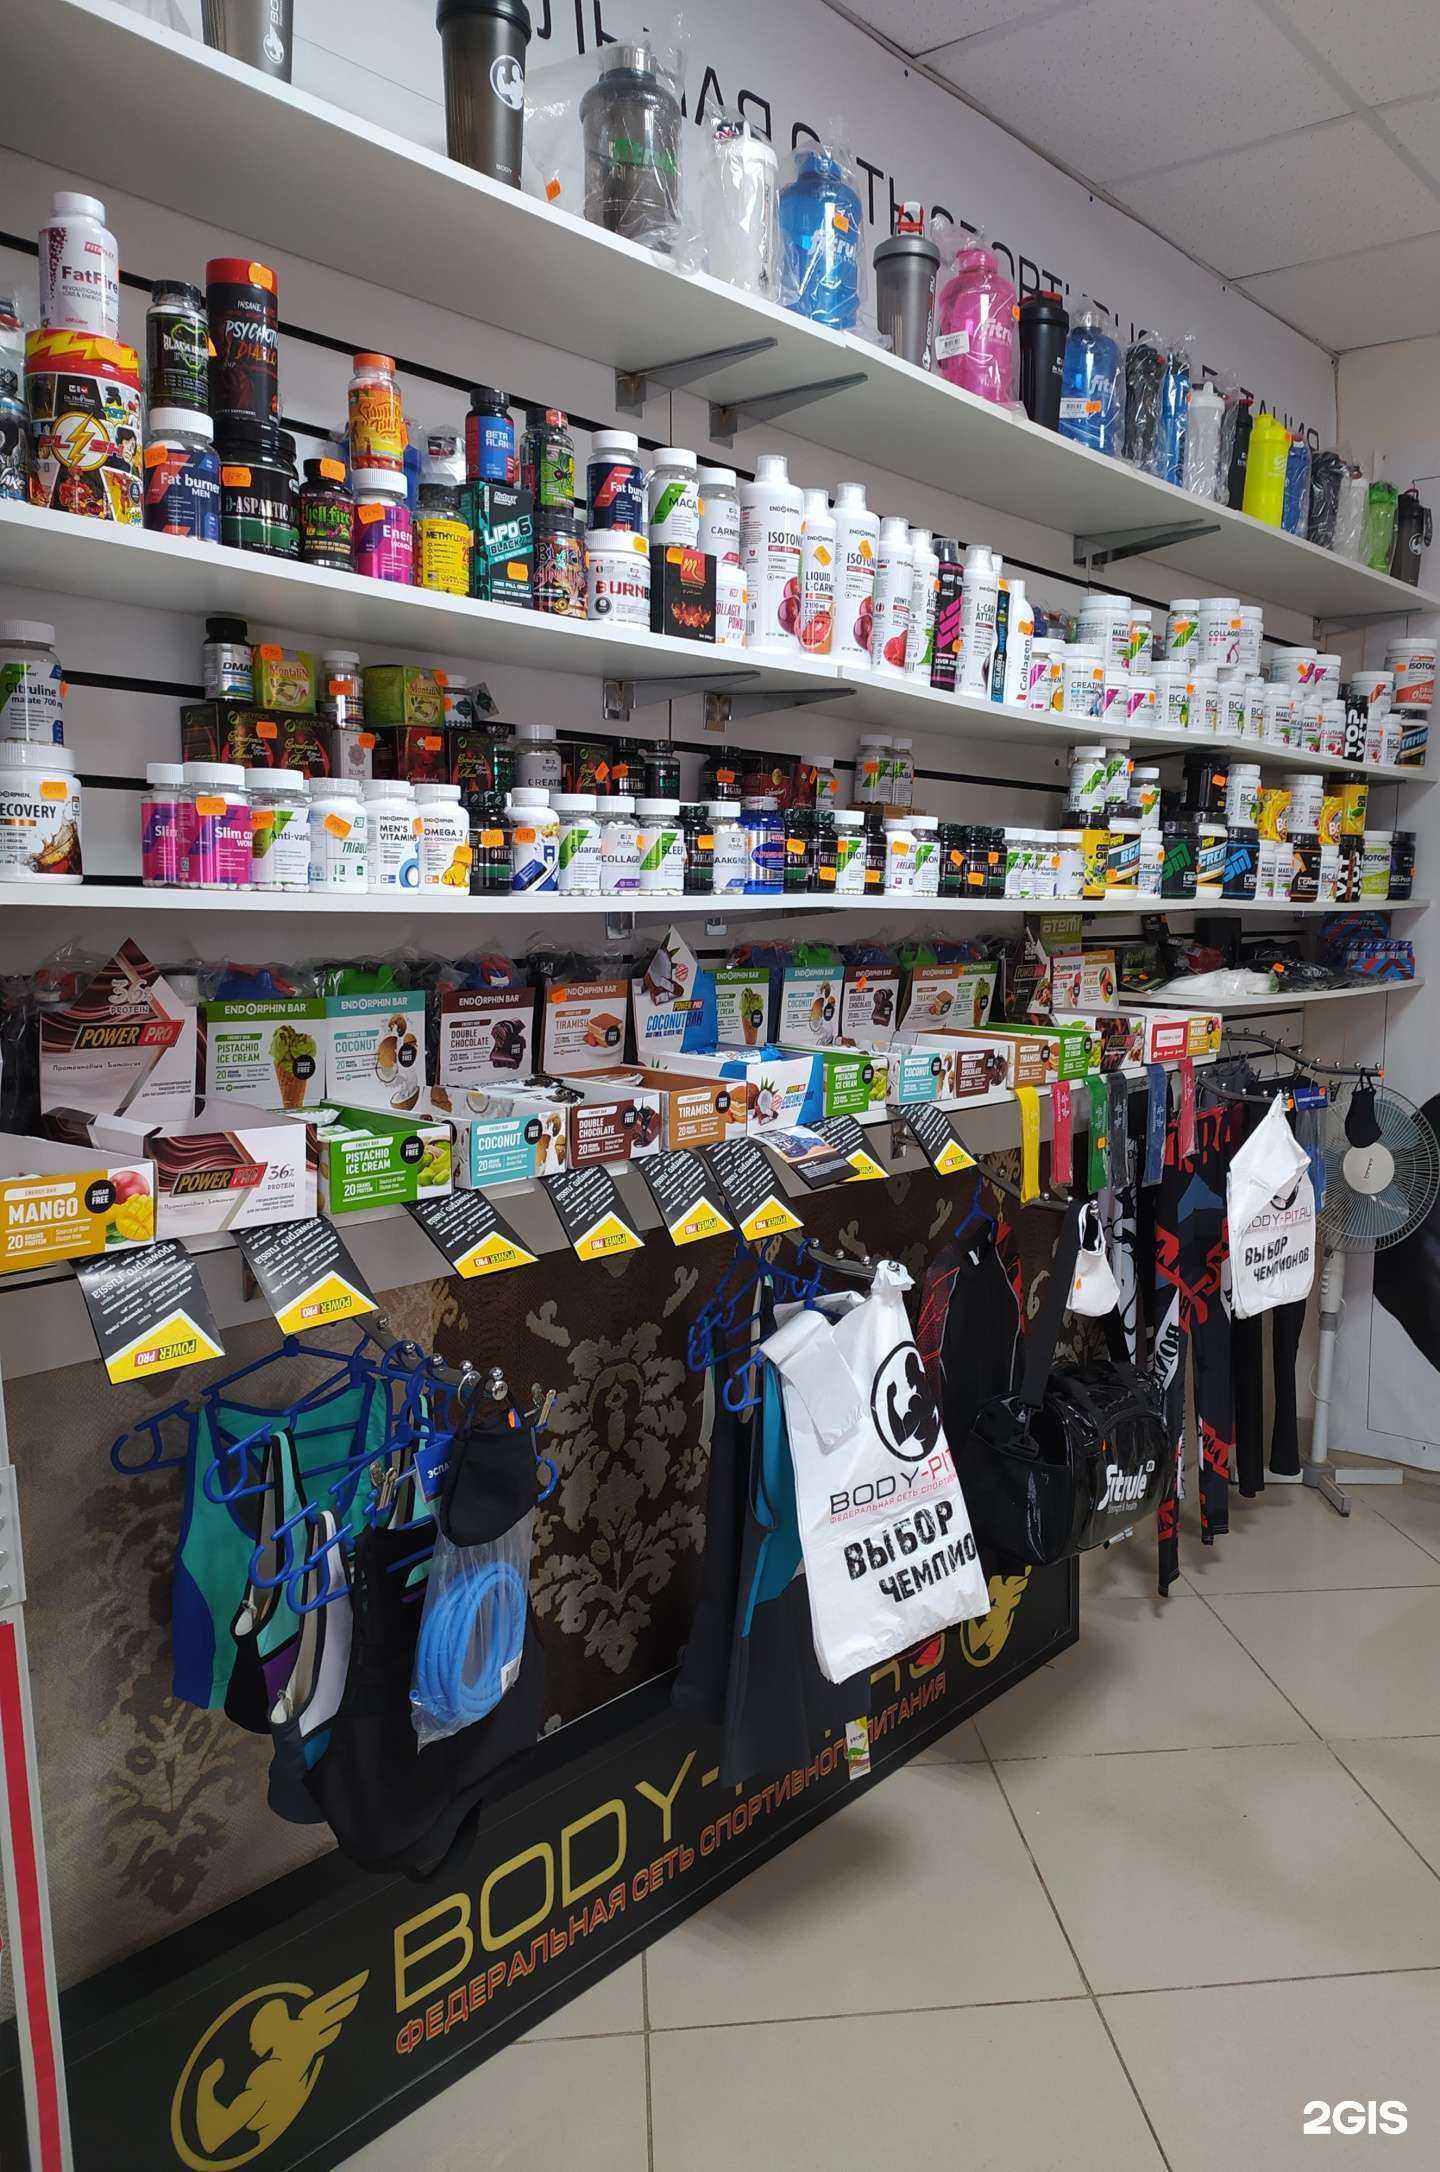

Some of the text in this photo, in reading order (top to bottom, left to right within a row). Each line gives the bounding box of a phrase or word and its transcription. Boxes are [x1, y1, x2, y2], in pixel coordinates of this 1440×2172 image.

[61, 266, 119, 294] FatFire
[486, 430, 509, 441] BETA
[160, 471, 182, 486] Fat
[191, 488, 211, 500] MEN
[610, 481, 627, 494] Fat
[489, 540, 521, 555] BLACK
[805, 571, 831, 582] LIQUID
[1019, 638, 1031, 691] Collagen
[214, 826, 240, 840] Slim
[423, 827, 457, 837] OMEGA
[602, 984, 618, 993] BAR
[391, 997, 408, 1006] BAR
[505, 994, 520, 1003] BAR
[111, 1004, 150, 1015] PROTEIN
[287, 1002, 307, 1013] BAR
[646, 1012, 686, 1031] COCONUT
[79, 1026, 173, 1048] POWER PRO
[451, 1029, 477, 1039] DOUBLE
[216, 1043, 260, 1054] PISTACHIO
[335, 1038, 377, 1054] COCONUT
[450, 1038, 489, 1049] CHOCOLATE
[216, 1052, 261, 1063] ICE CREAM
[216, 1070, 227, 1080] 20
[678, 1102, 715, 1119] TIRAMISU
[578, 1117, 605, 1129] DOUBLE
[578, 1125, 615, 1139] CHOCOLATE
[678, 1126, 687, 1137] 20
[478, 1132, 523, 1151] COCONUT
[345, 1147, 390, 1164] PISTACHIO
[404, 1148, 420, 1158] FREE
[578, 1144, 588, 1156] 20
[345, 1159, 391, 1175] ICE CREAM
[478, 1160, 488, 1172] 20
[177, 1171, 232, 1194] POWER
[267, 1181, 296, 1191] PROTEIN
[91, 1188, 110, 1206] SUGAR FREE
[343, 1183, 357, 1197] 20
[8, 1196, 79, 1227] MANGO
[7, 1234, 24, 1251] 20
[1245, 1236, 1288, 1266] ВЫБОР
[1253, 1247, 1310, 1282] ЧЕМПИОНОВ
[302, 1296, 352, 1319] POWER PRO
[136, 1339, 197, 1366] POWER PRO
[843, 1500, 954, 1581] ВЫБОР
[395, 1880, 626, 2055] ФЕДЕРАЛЬНАЯ
[631, 1843, 694, 1904] СЕТЬ
